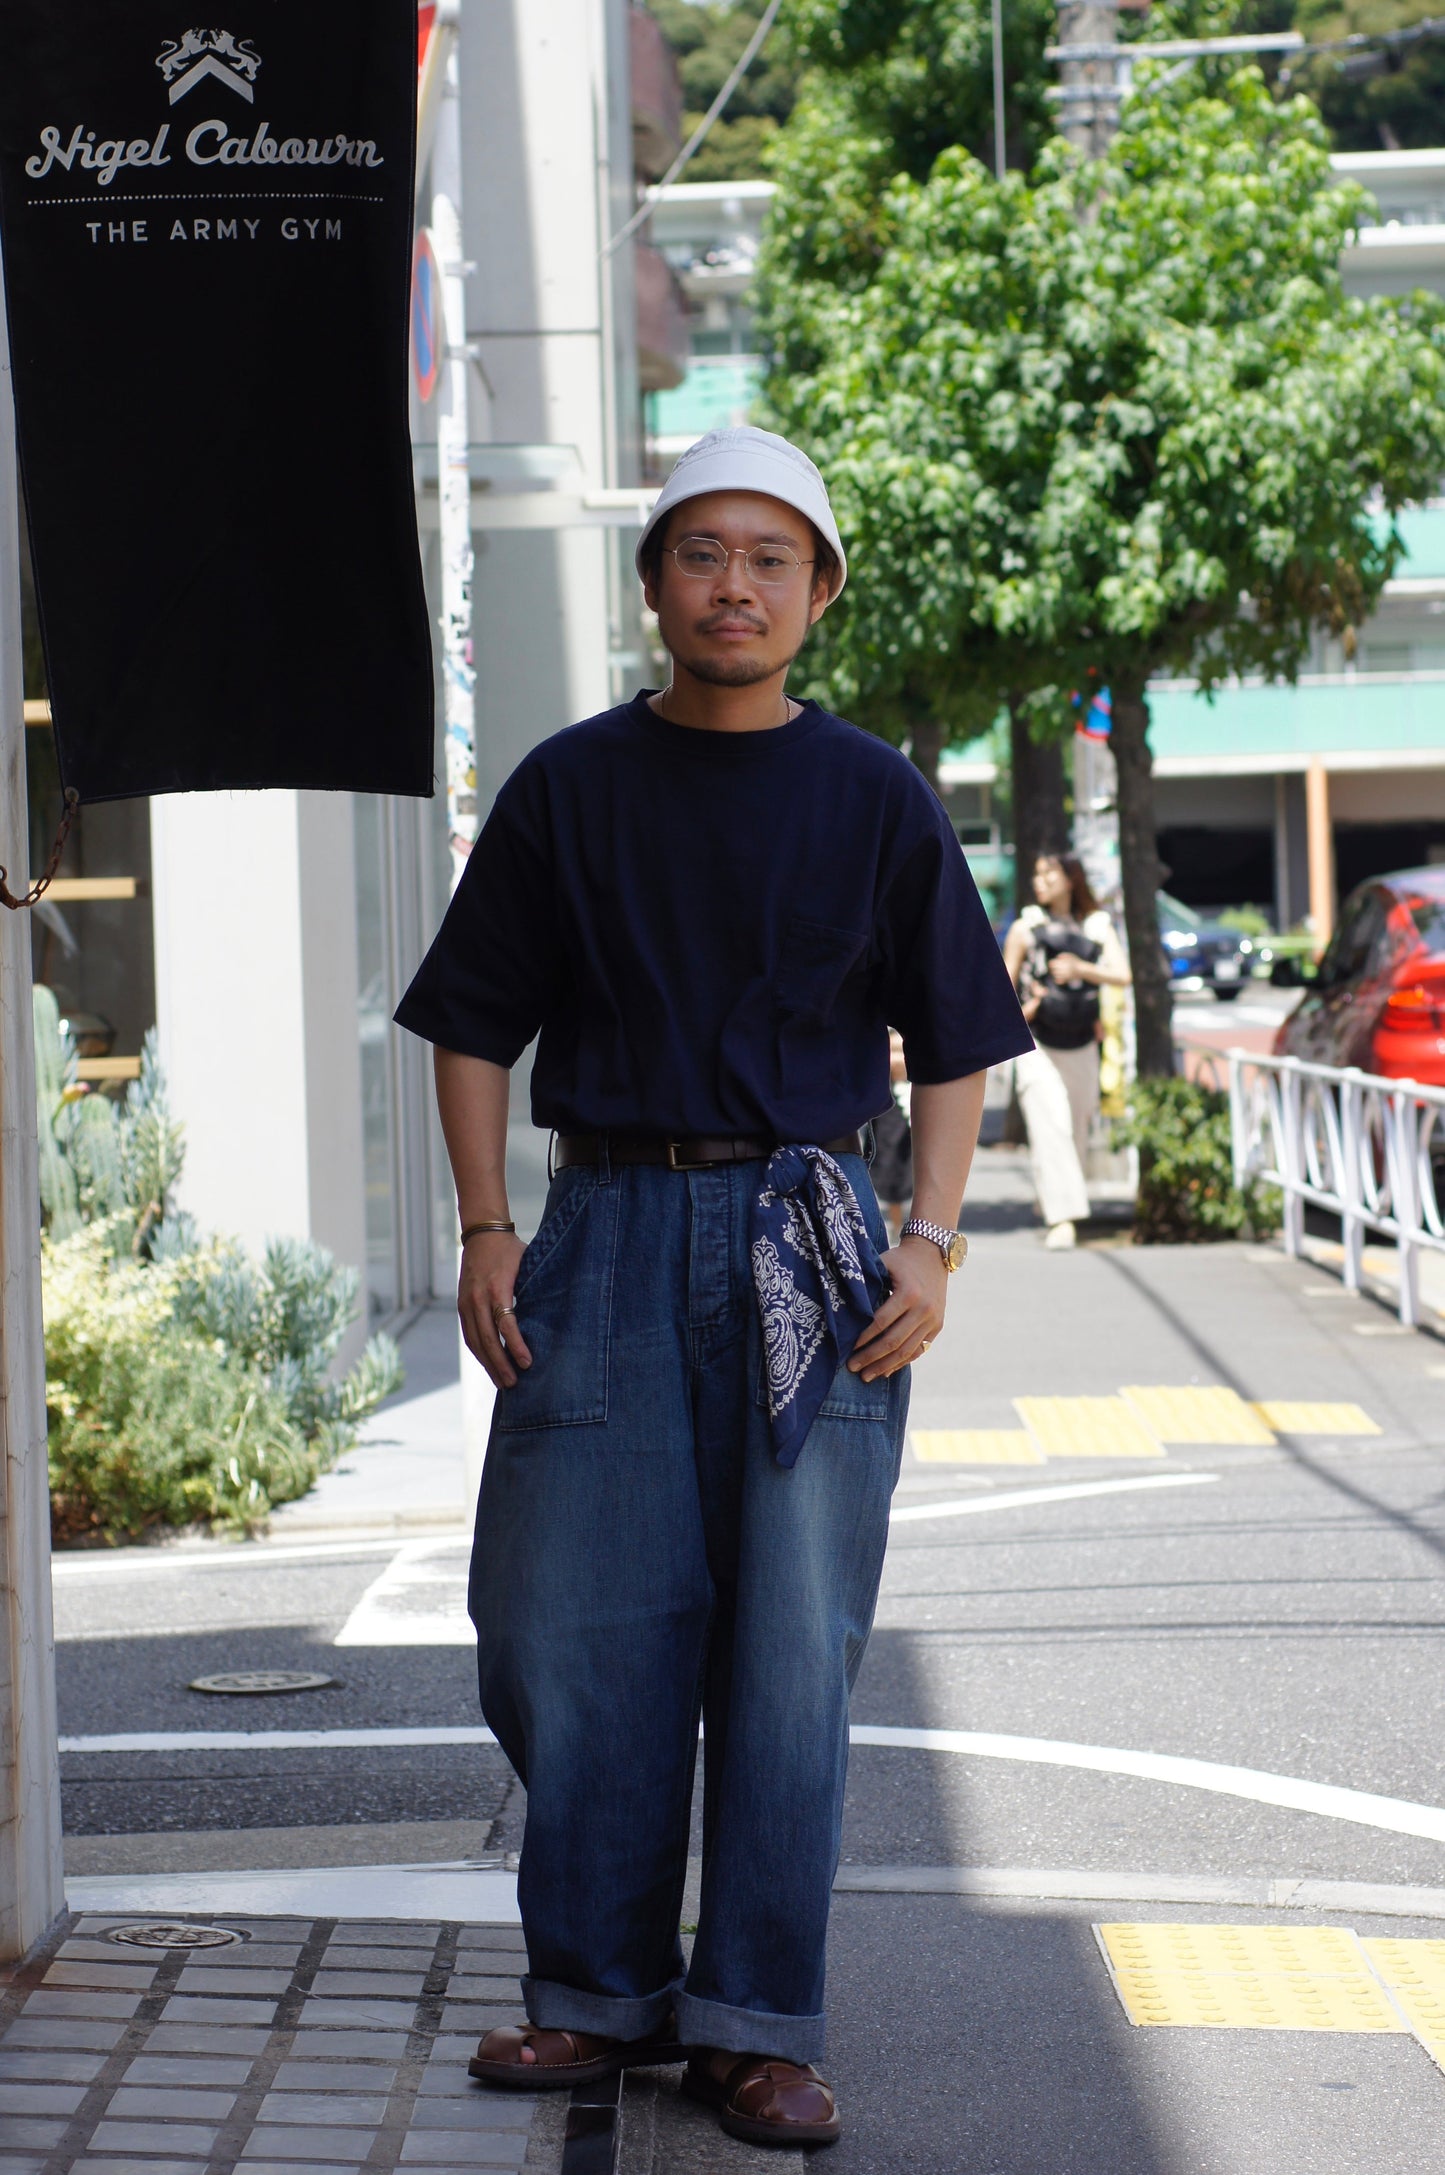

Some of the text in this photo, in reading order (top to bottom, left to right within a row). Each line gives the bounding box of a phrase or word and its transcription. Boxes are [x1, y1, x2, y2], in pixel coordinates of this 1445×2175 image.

[25, 119, 384, 185] Nigel Cabourn
[86, 218, 342, 243] THE ARMY GYM
